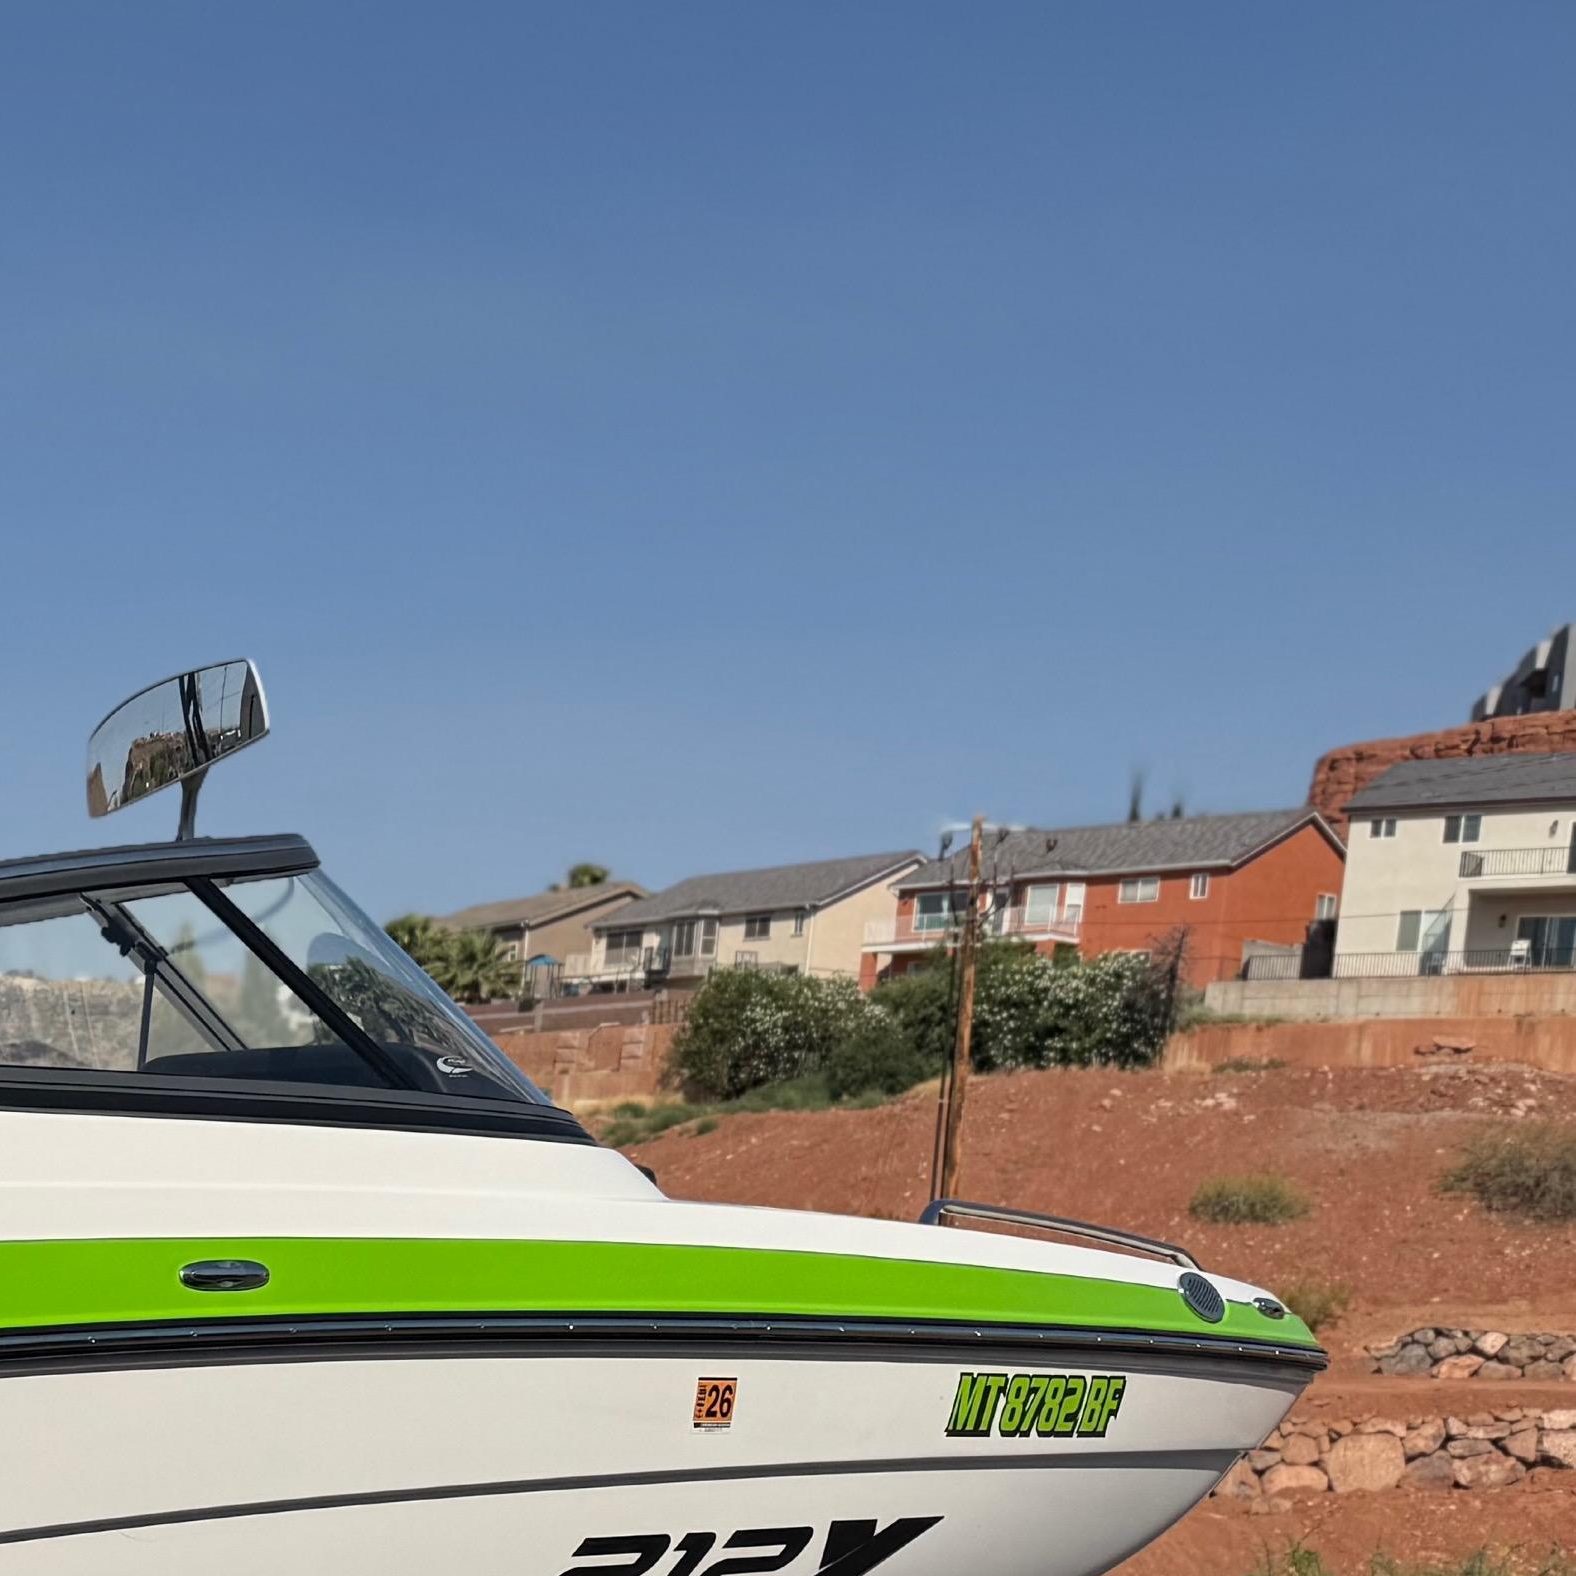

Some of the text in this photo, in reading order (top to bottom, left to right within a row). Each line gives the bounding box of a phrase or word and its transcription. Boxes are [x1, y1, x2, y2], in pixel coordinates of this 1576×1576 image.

[705, 1384, 733, 1418] 26
[945, 1372, 1126, 1438] MT 8782 BF
